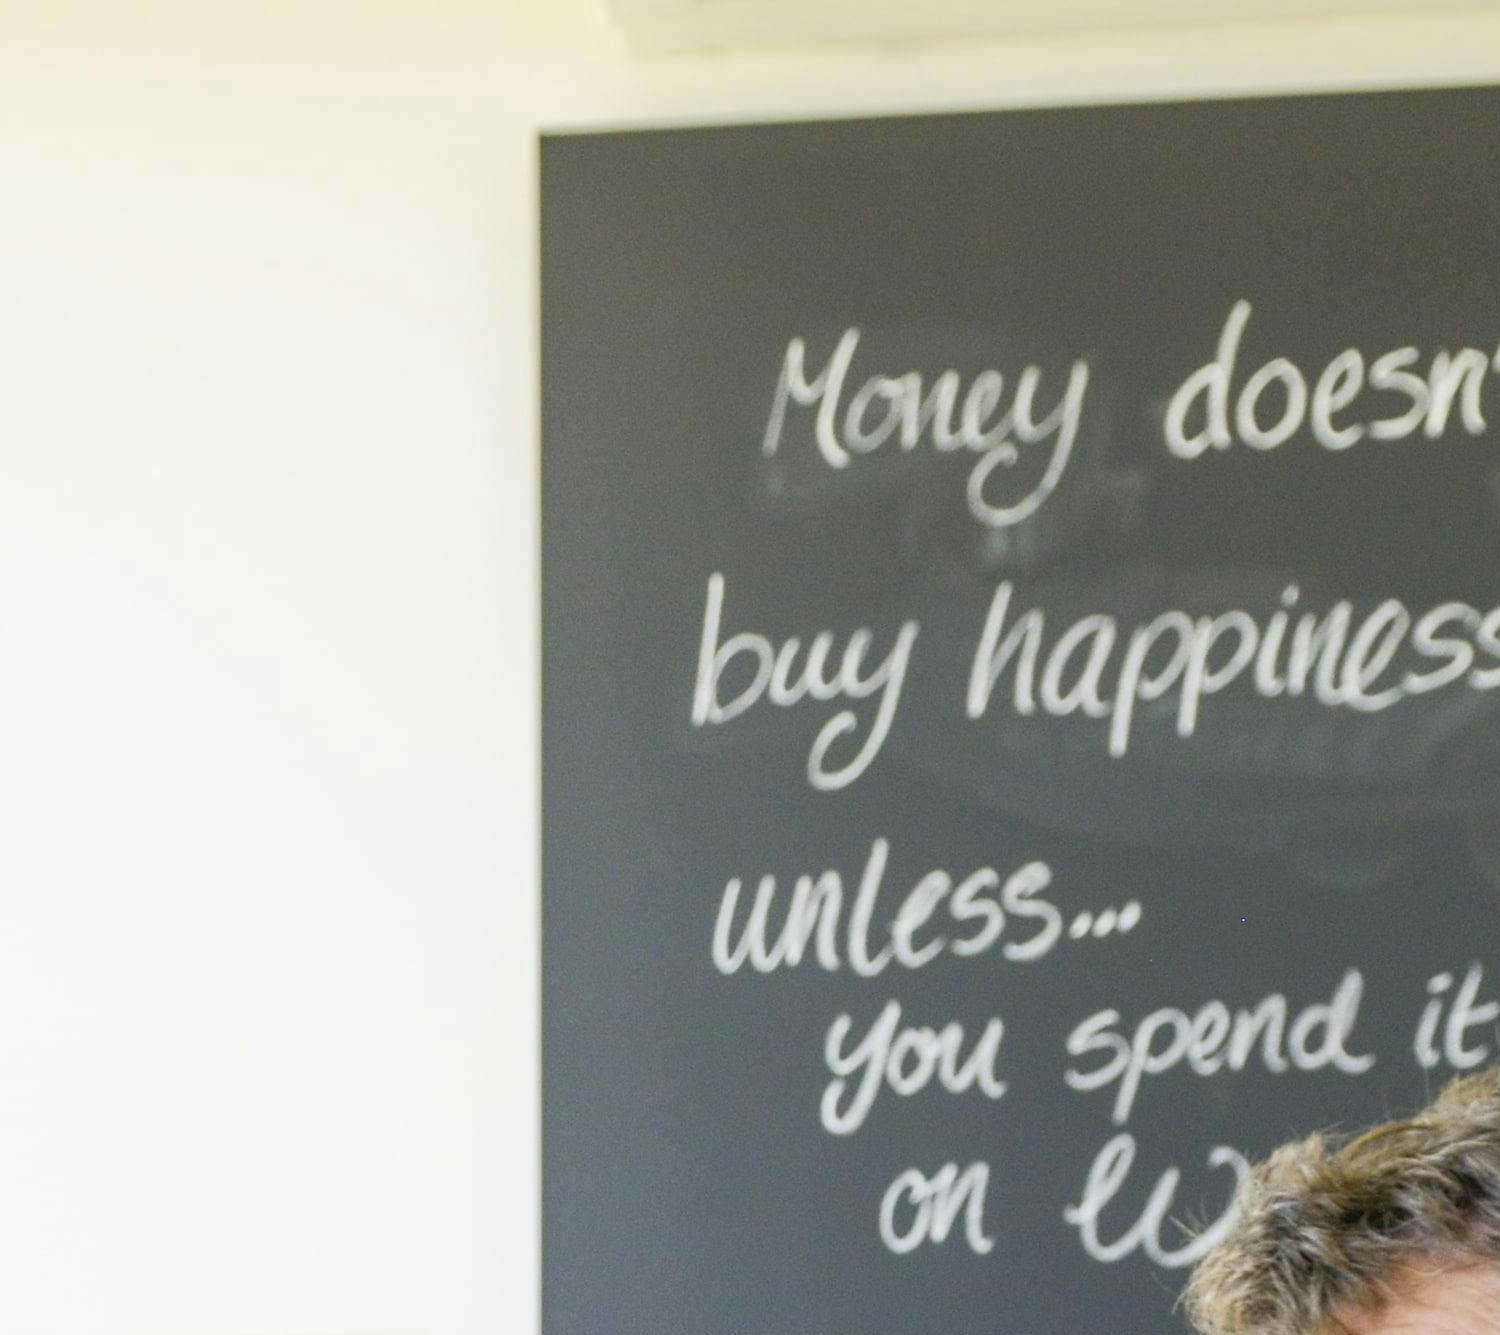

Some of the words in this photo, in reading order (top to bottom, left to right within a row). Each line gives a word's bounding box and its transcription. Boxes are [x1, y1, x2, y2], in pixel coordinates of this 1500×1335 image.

[762, 327, 1089, 525] Money
[690, 571, 921, 791] buy
[819, 999, 1007, 1136] you
[1064, 968, 1375, 1122] spend
[1414, 963, 1500, 1069] it
[878, 1160, 996, 1256] on
